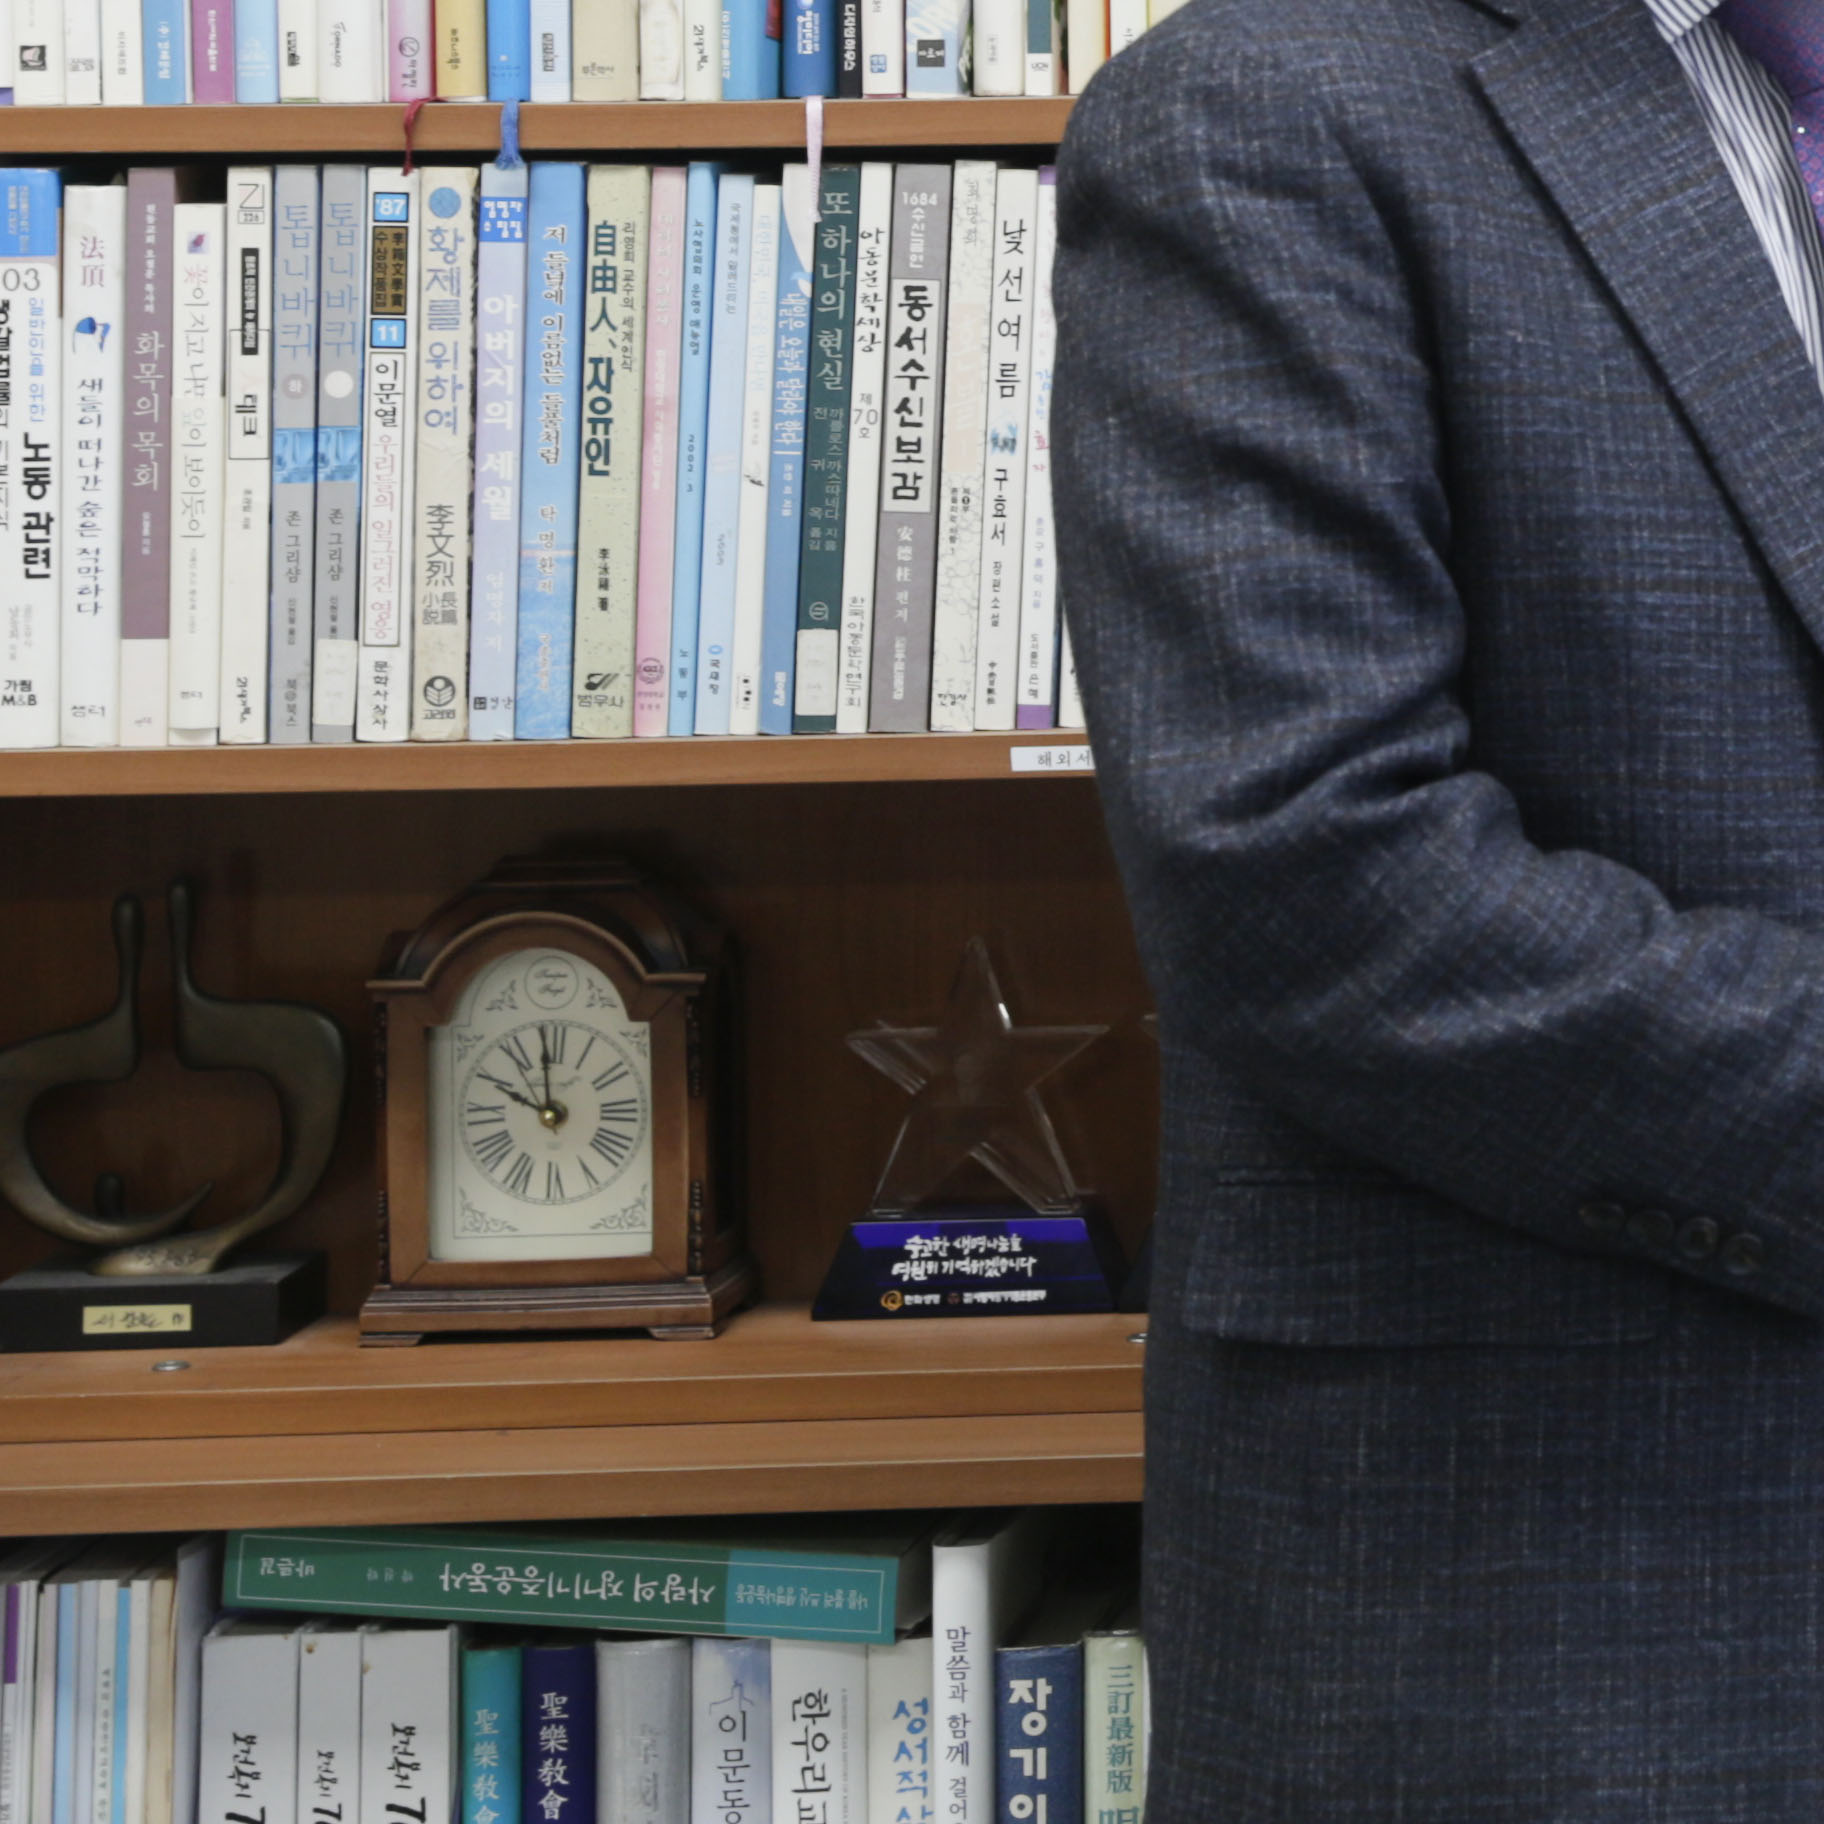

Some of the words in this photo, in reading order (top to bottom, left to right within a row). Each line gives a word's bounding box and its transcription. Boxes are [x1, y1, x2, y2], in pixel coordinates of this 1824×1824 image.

[584, 357, 616, 477] 자유인
[892, 285, 933, 502] 동서수신보감
[22, 432, 53, 500] 노동
[22, 512, 55, 580] 관련
[634, 1573, 715, 1605] 사랑의
[946, 1626, 971, 1704] 말씀과
[945, 1713, 971, 1766] 함께
